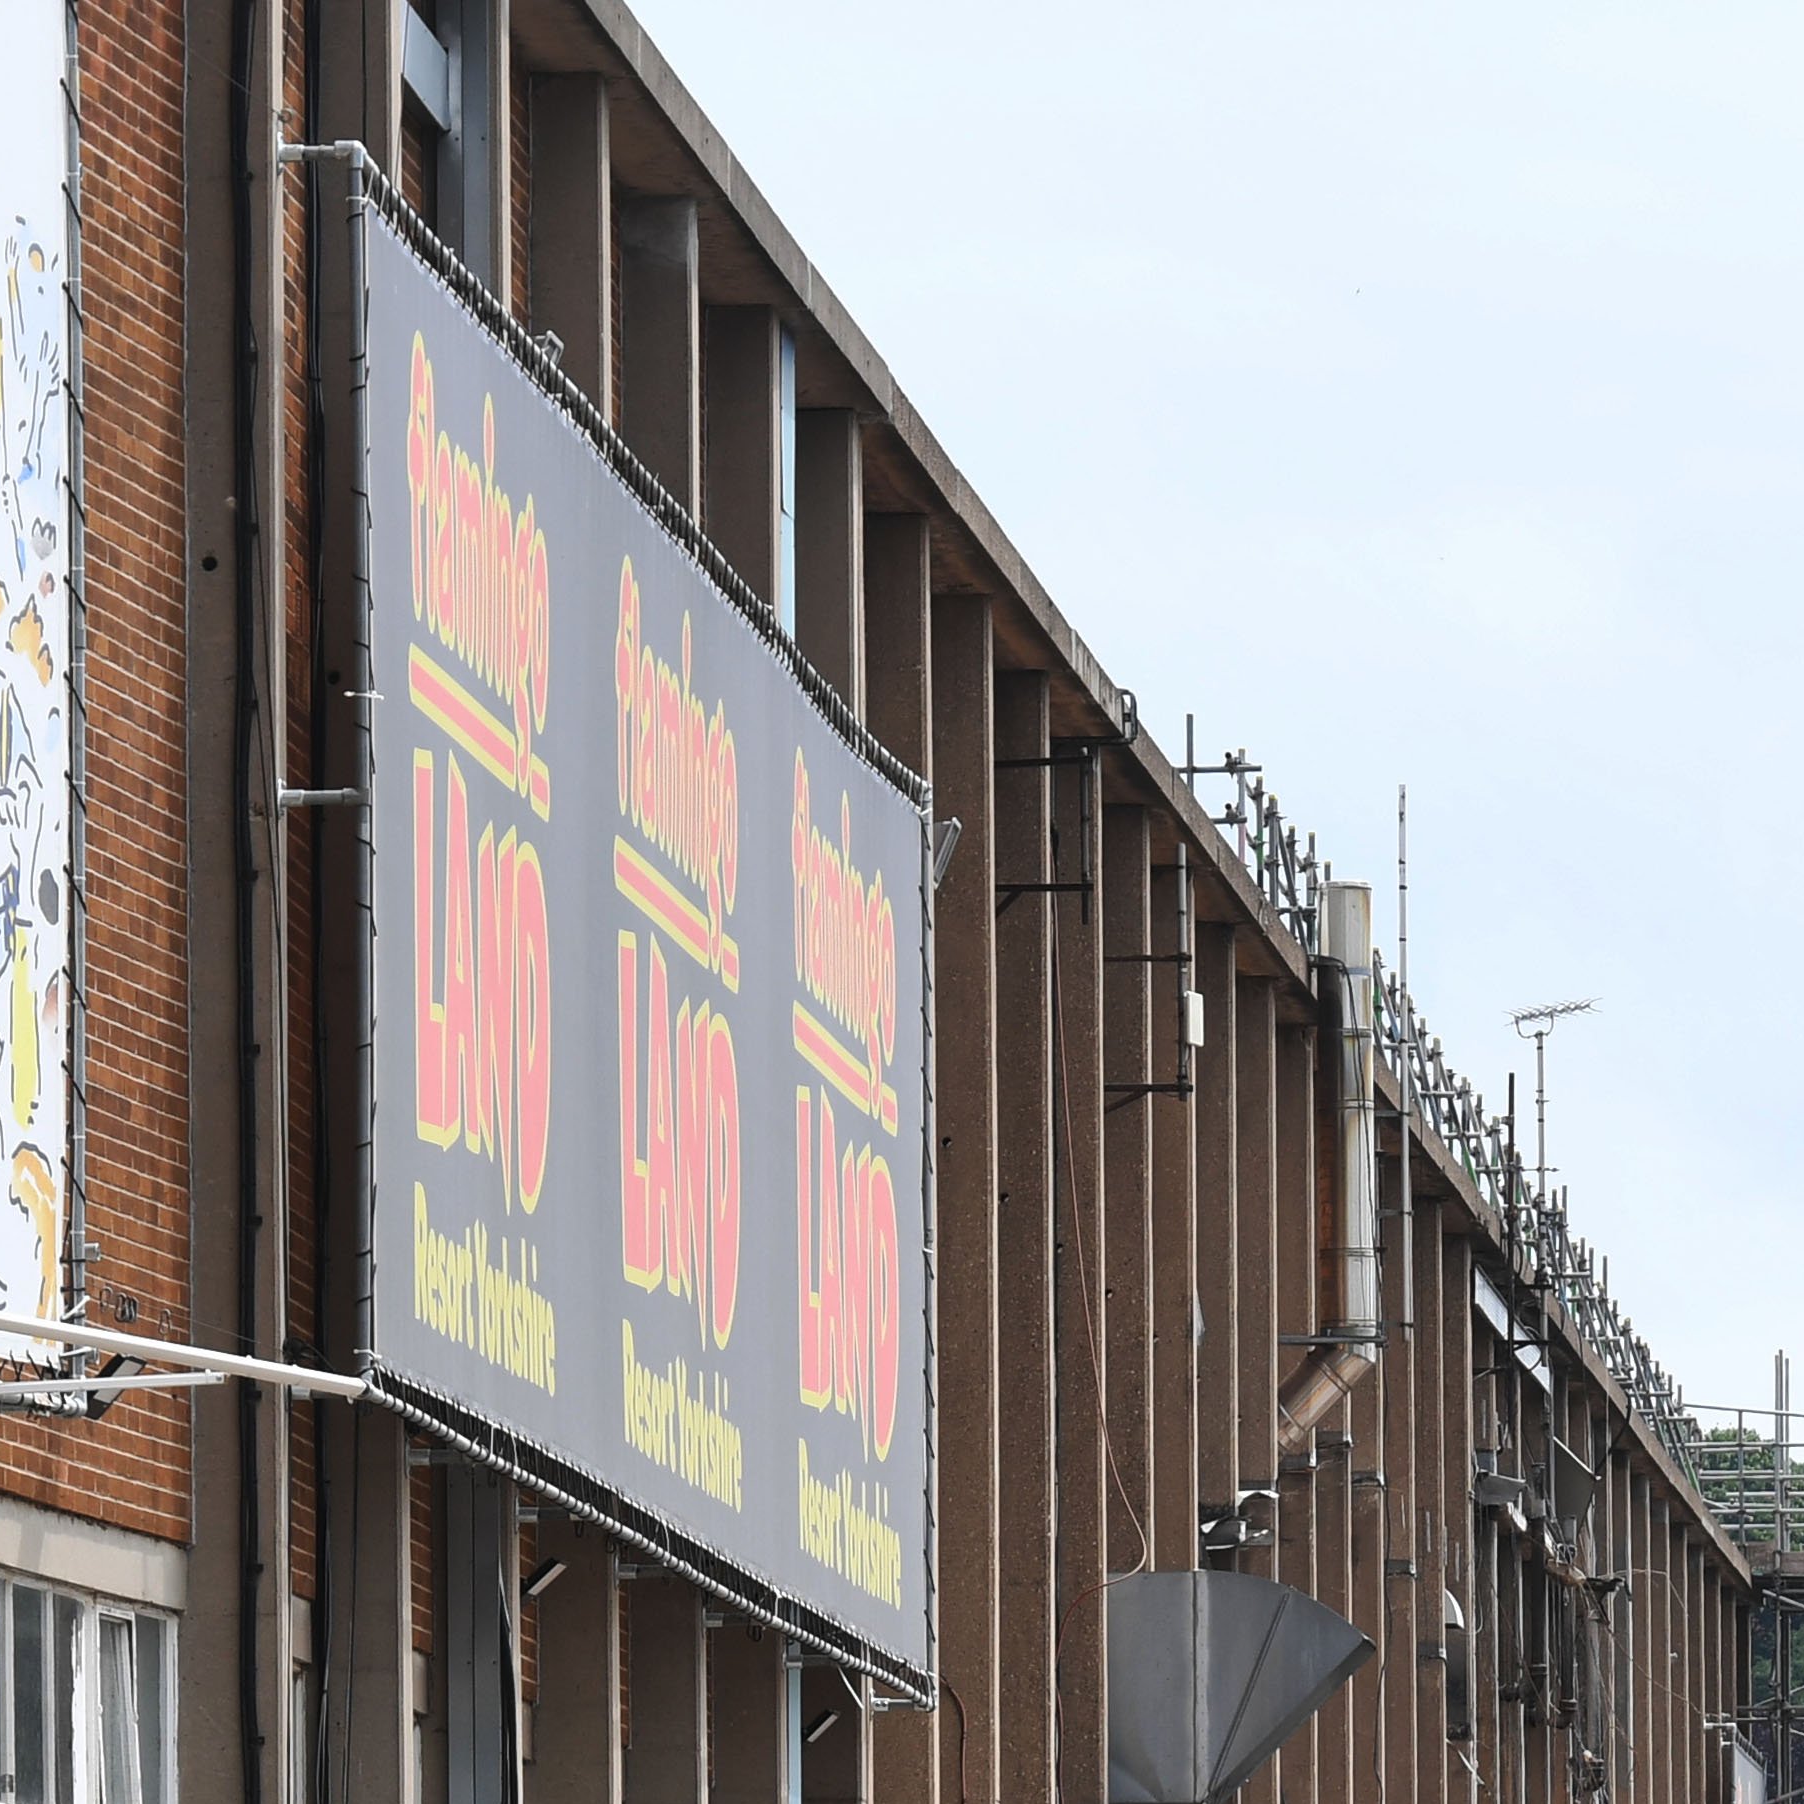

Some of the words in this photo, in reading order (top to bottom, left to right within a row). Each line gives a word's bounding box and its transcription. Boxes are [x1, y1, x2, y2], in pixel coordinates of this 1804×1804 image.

[414, 747, 552, 1215] LAND
[618, 931, 740, 1350] LAND
[796, 1086, 900, 1463] LAND
[414, 1181, 474, 1350] Resort
[474, 1219, 555, 1398] Yorkshire
[622, 1319, 676, 1467] Resort
[675, 1355, 742, 1513] Yorkshire
[799, 1439, 842, 1565] Resort
[840, 1467, 902, 1612] Yorkshire
